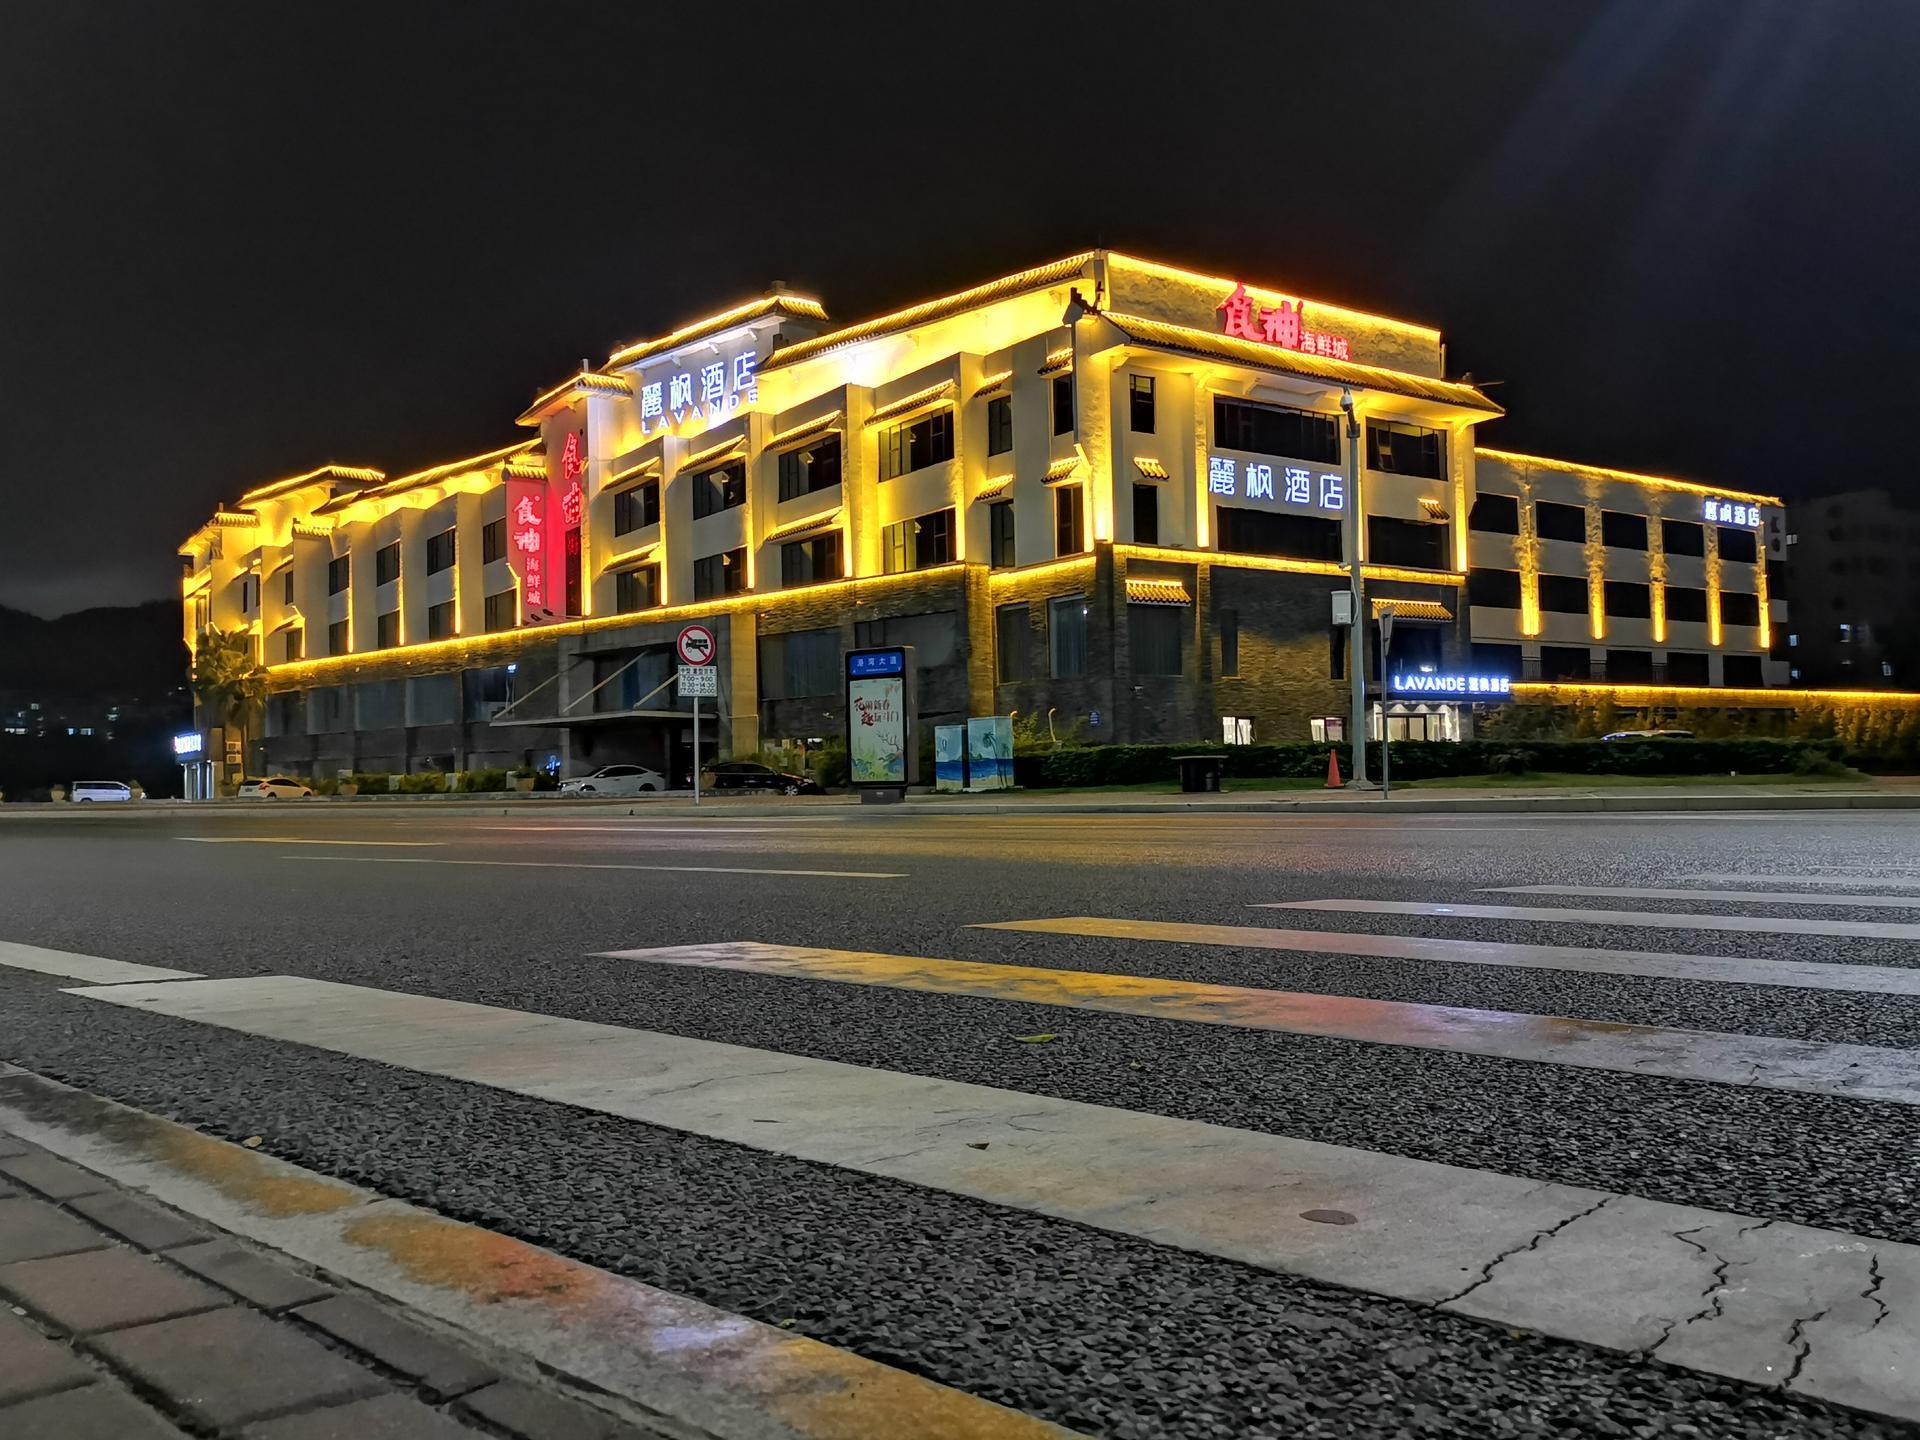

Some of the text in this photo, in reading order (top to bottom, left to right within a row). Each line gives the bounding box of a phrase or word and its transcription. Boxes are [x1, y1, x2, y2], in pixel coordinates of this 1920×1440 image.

[1216, 282, 1349, 361] 食神 海鲜城
[641, 387, 758, 434] LAVANDE
[1209, 457, 1343, 510] 麗枫酒店
[514, 496, 542, 605] 食神 海鲜城
[1394, 675, 1466, 692] LAVANDE
